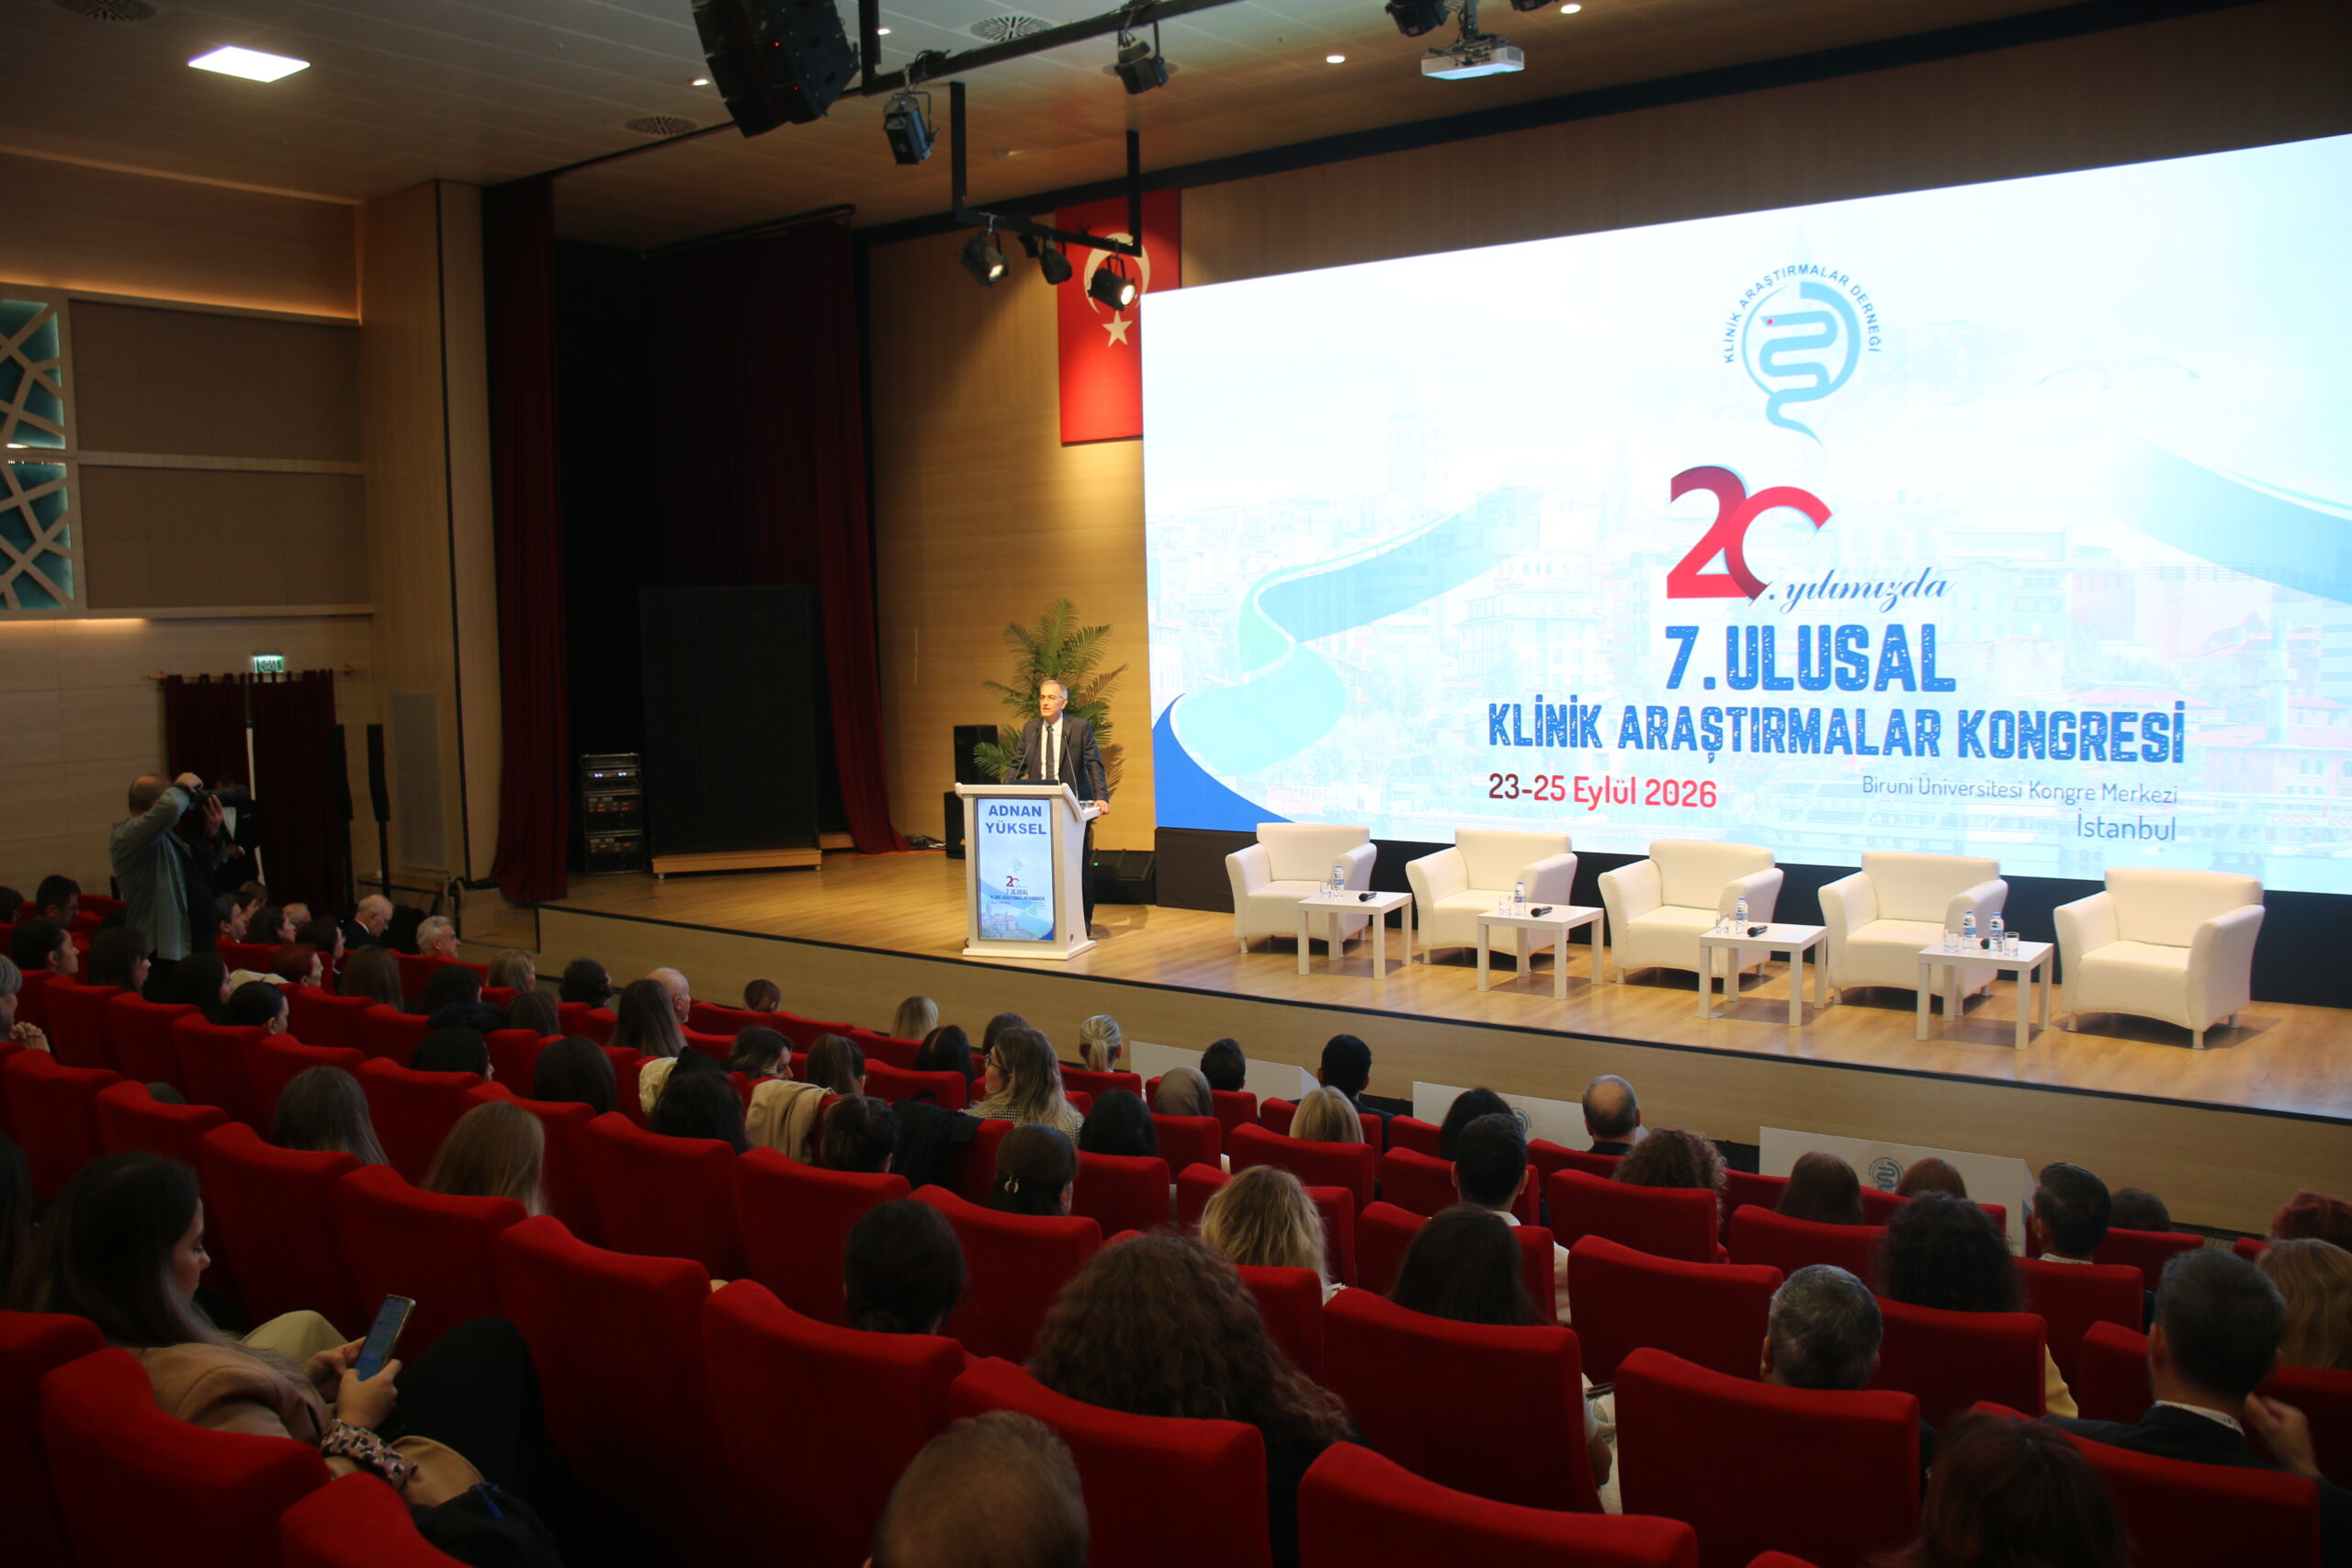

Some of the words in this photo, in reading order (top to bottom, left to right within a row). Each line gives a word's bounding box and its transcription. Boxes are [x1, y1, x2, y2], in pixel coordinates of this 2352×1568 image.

[1739, 264, 1849, 310] ARAŞTIRMALAR
[1488, 694, 1603, 749] KLİNİK
[1618, 705, 1941, 764] ARAŞTIRMALAR
[1958, 700, 2186, 763] KONGRESİ
[1488, 773, 1566, 802] 23-25
[1574, 775, 1636, 811] Eylül
[1645, 779, 1717, 808] 2026
[1862, 775, 1913, 795] Biruni
[1918, 772, 2022, 799] Üniversitesi
[2030, 781, 2096, 806] Kongre
[2102, 784, 2178, 805] Merkezi
[985, 820, 1047, 835] YÜKSEL
[988, 805, 1042, 818] ADNAN
[2076, 807, 2176, 841] İstanbul
